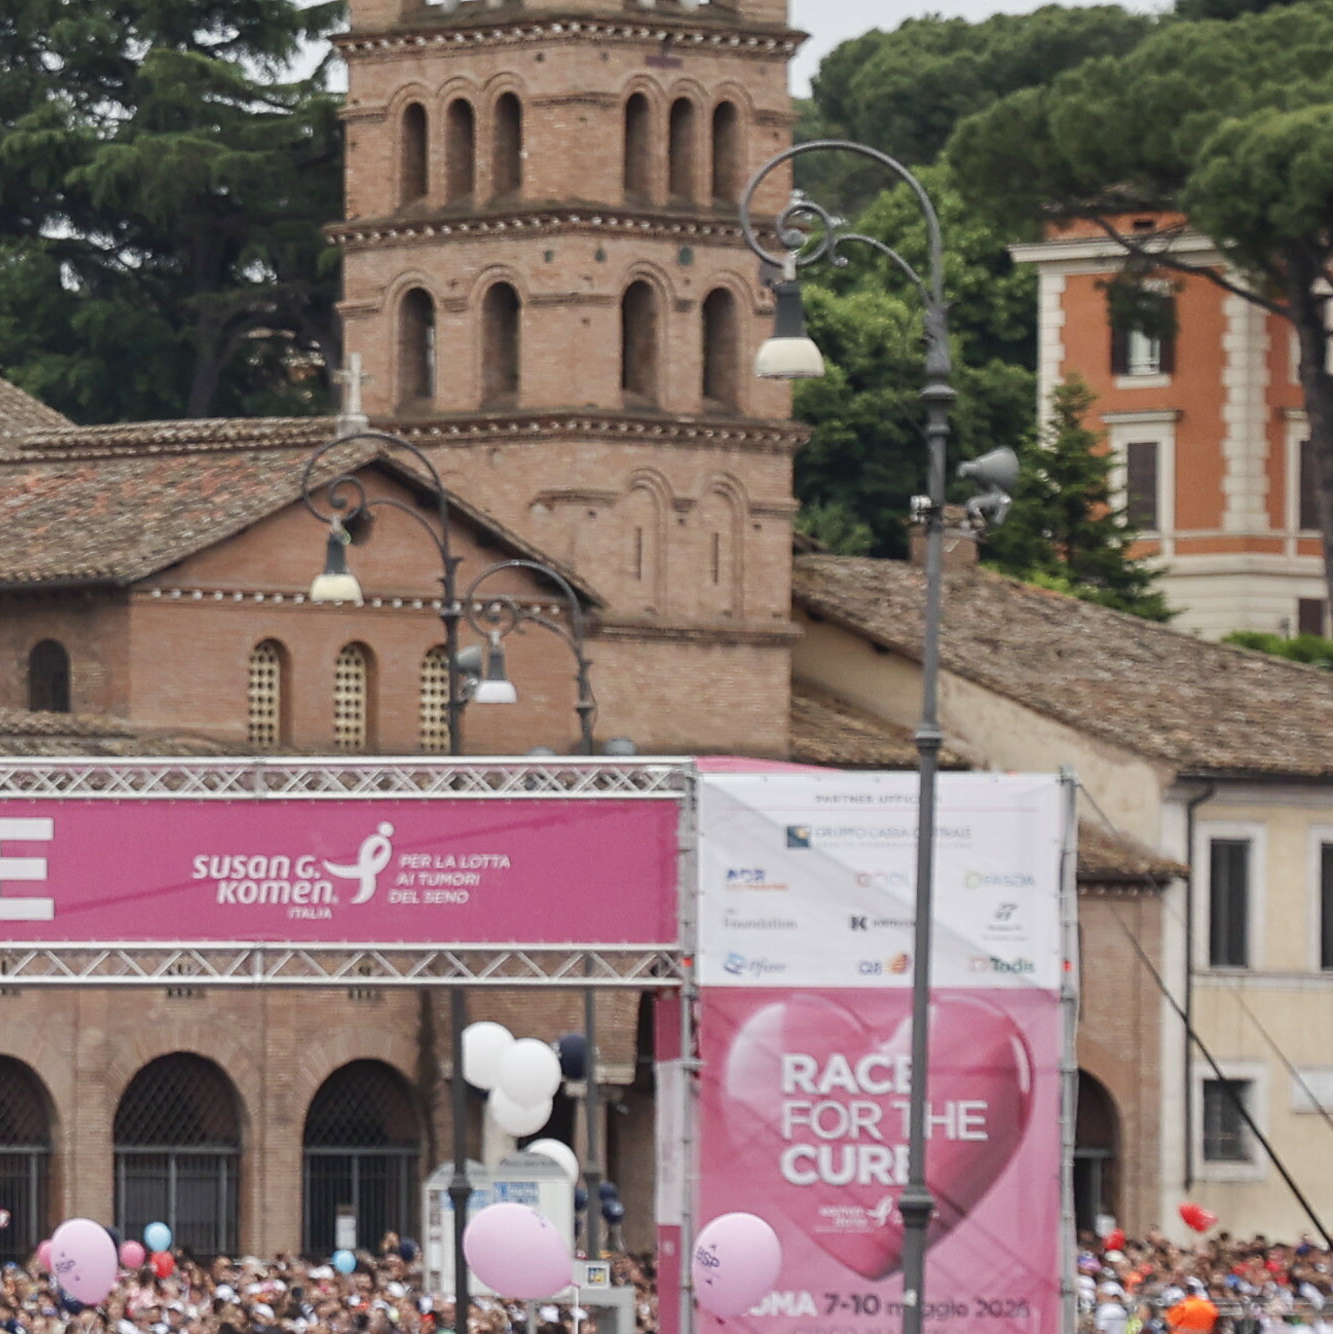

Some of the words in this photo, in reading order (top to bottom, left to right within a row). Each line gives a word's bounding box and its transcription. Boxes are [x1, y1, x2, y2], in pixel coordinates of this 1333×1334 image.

[813, 793, 875, 806] PARTNER
[399, 854, 432, 869] PER
[435, 854, 457, 869] LA
[460, 854, 511, 869] LOTTA
[396, 872, 415, 887] AI
[418, 872, 480, 887] TUMORI
[389, 890, 420, 904] DEL
[424, 890, 469, 904] SENO
[287, 906, 333, 920] ITALIA
[781, 1100, 883, 1140] FOR
[744, 1290, 817, 1318] OMA
[824, 1293, 880, 1316] 7-10
[886, 1295, 968, 1321] mggio
[975, 1296, 1031, 1318] 2026
